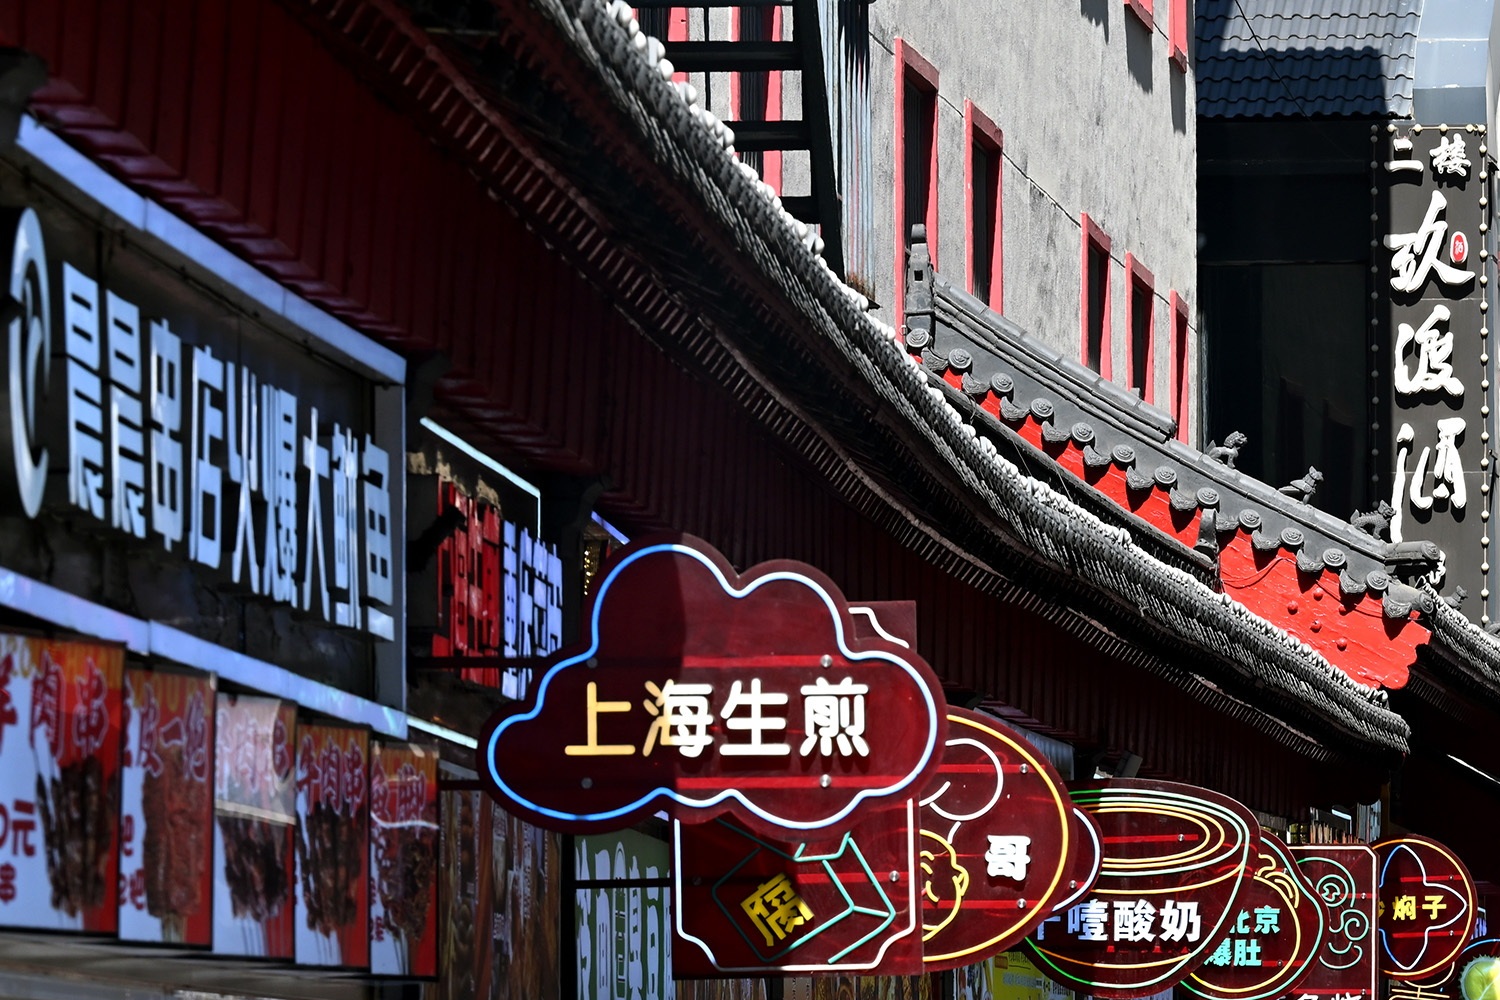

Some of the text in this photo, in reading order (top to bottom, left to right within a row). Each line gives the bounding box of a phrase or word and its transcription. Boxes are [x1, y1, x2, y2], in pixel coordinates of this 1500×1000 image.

[1384, 133, 1473, 177] 二楼
[63, 262, 395, 642] 晨晨串店火爆大鱿鱼
[565, 676, 870, 758] 上海生煎
[740, 872, 815, 947] 腐
